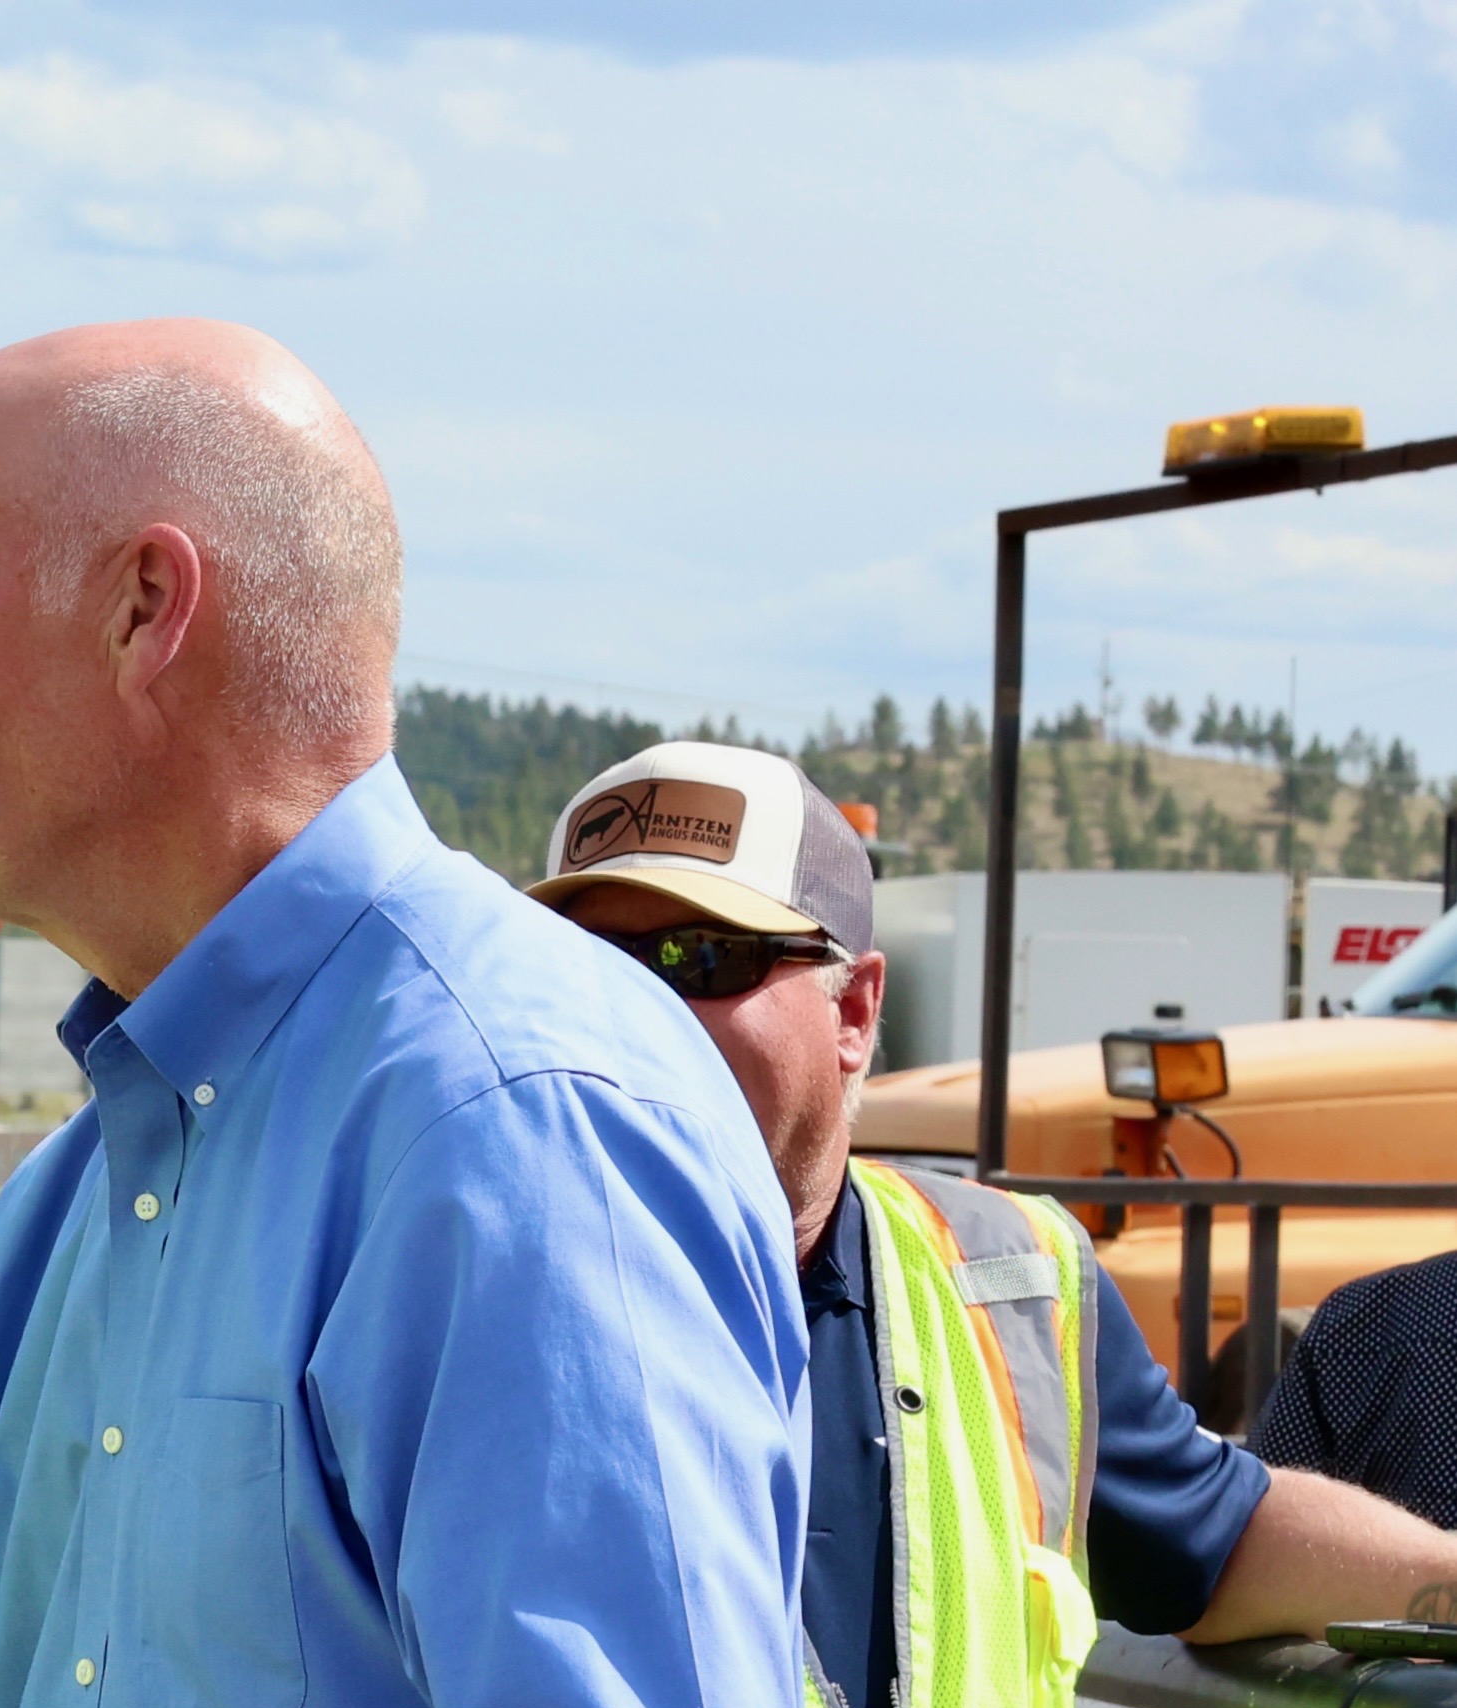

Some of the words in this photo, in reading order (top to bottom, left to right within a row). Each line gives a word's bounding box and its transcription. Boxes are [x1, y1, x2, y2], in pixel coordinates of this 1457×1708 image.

[631, 783, 732, 846] ARNTZEN
[649, 826, 688, 841] ANGUS
[690, 830, 730, 849] RANCH
